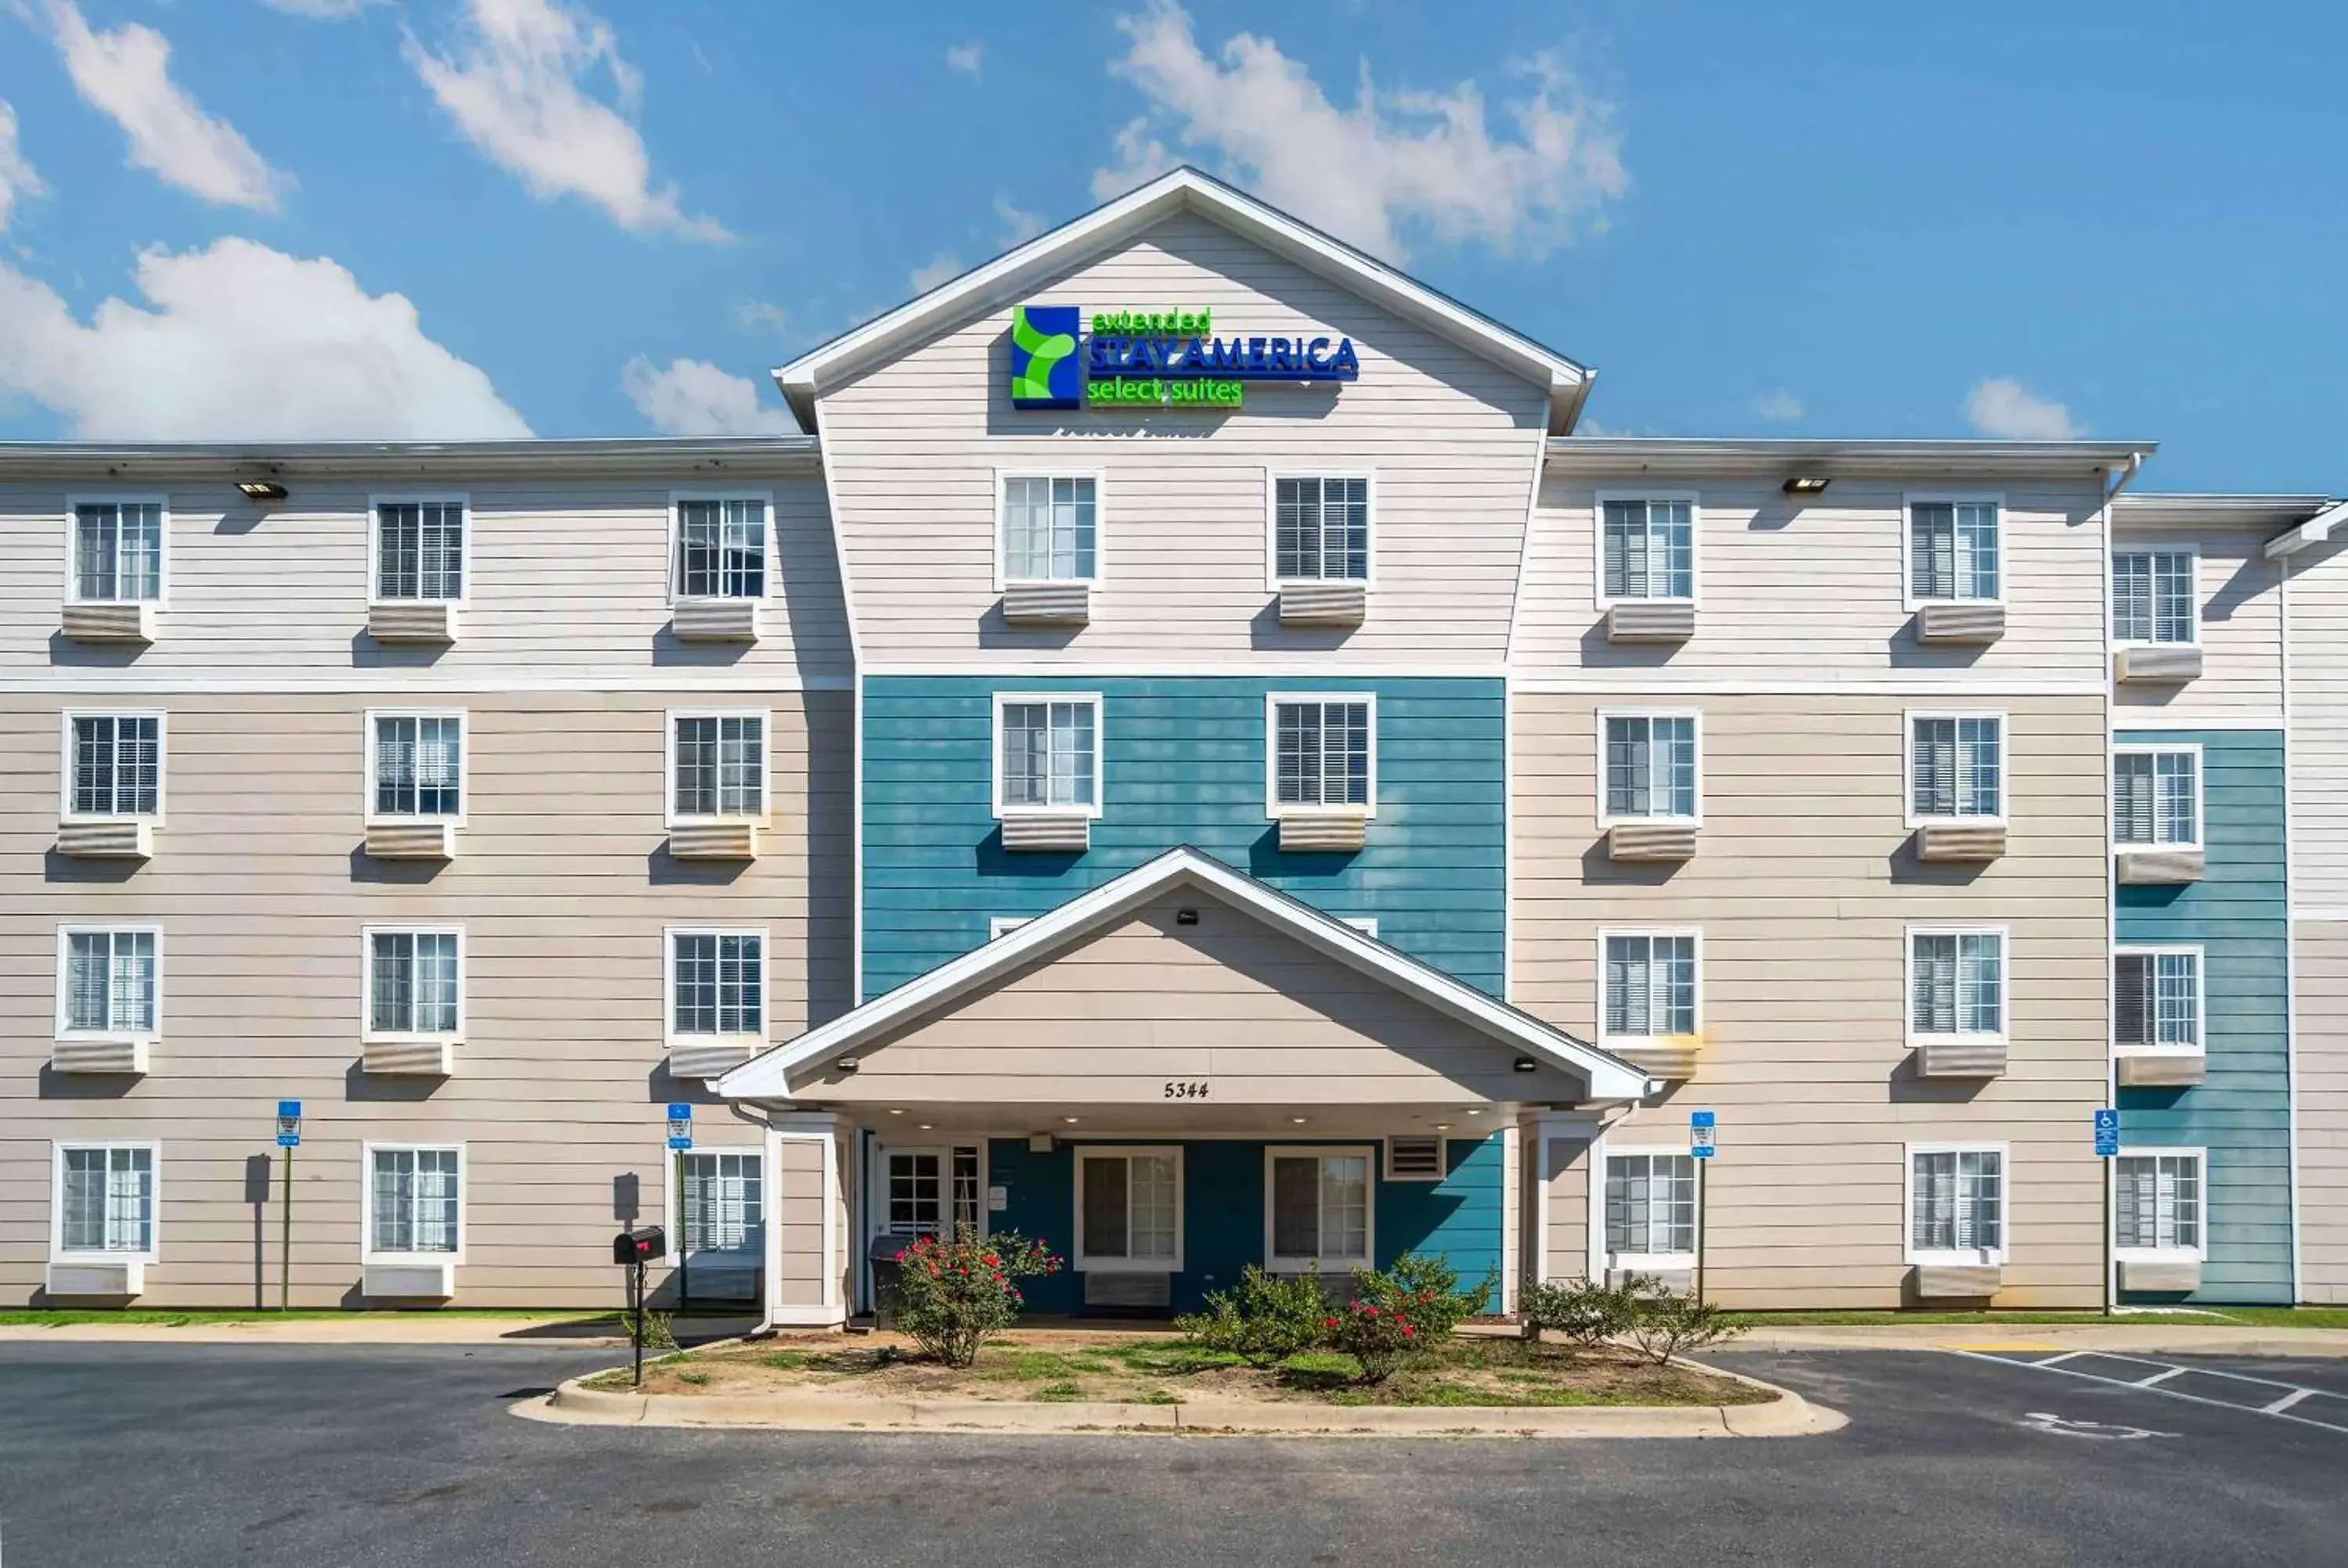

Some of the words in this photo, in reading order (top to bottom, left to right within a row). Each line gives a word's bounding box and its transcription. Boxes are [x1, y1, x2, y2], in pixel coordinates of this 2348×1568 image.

[1092, 307, 1211, 333] extended
[1090, 337, 1178, 369] STAY
[1182, 337, 1359, 372] AMERICA
[1087, 376, 1162, 401] select
[1172, 377, 1242, 403] suites
[1165, 1082, 1208, 1098] 5344
